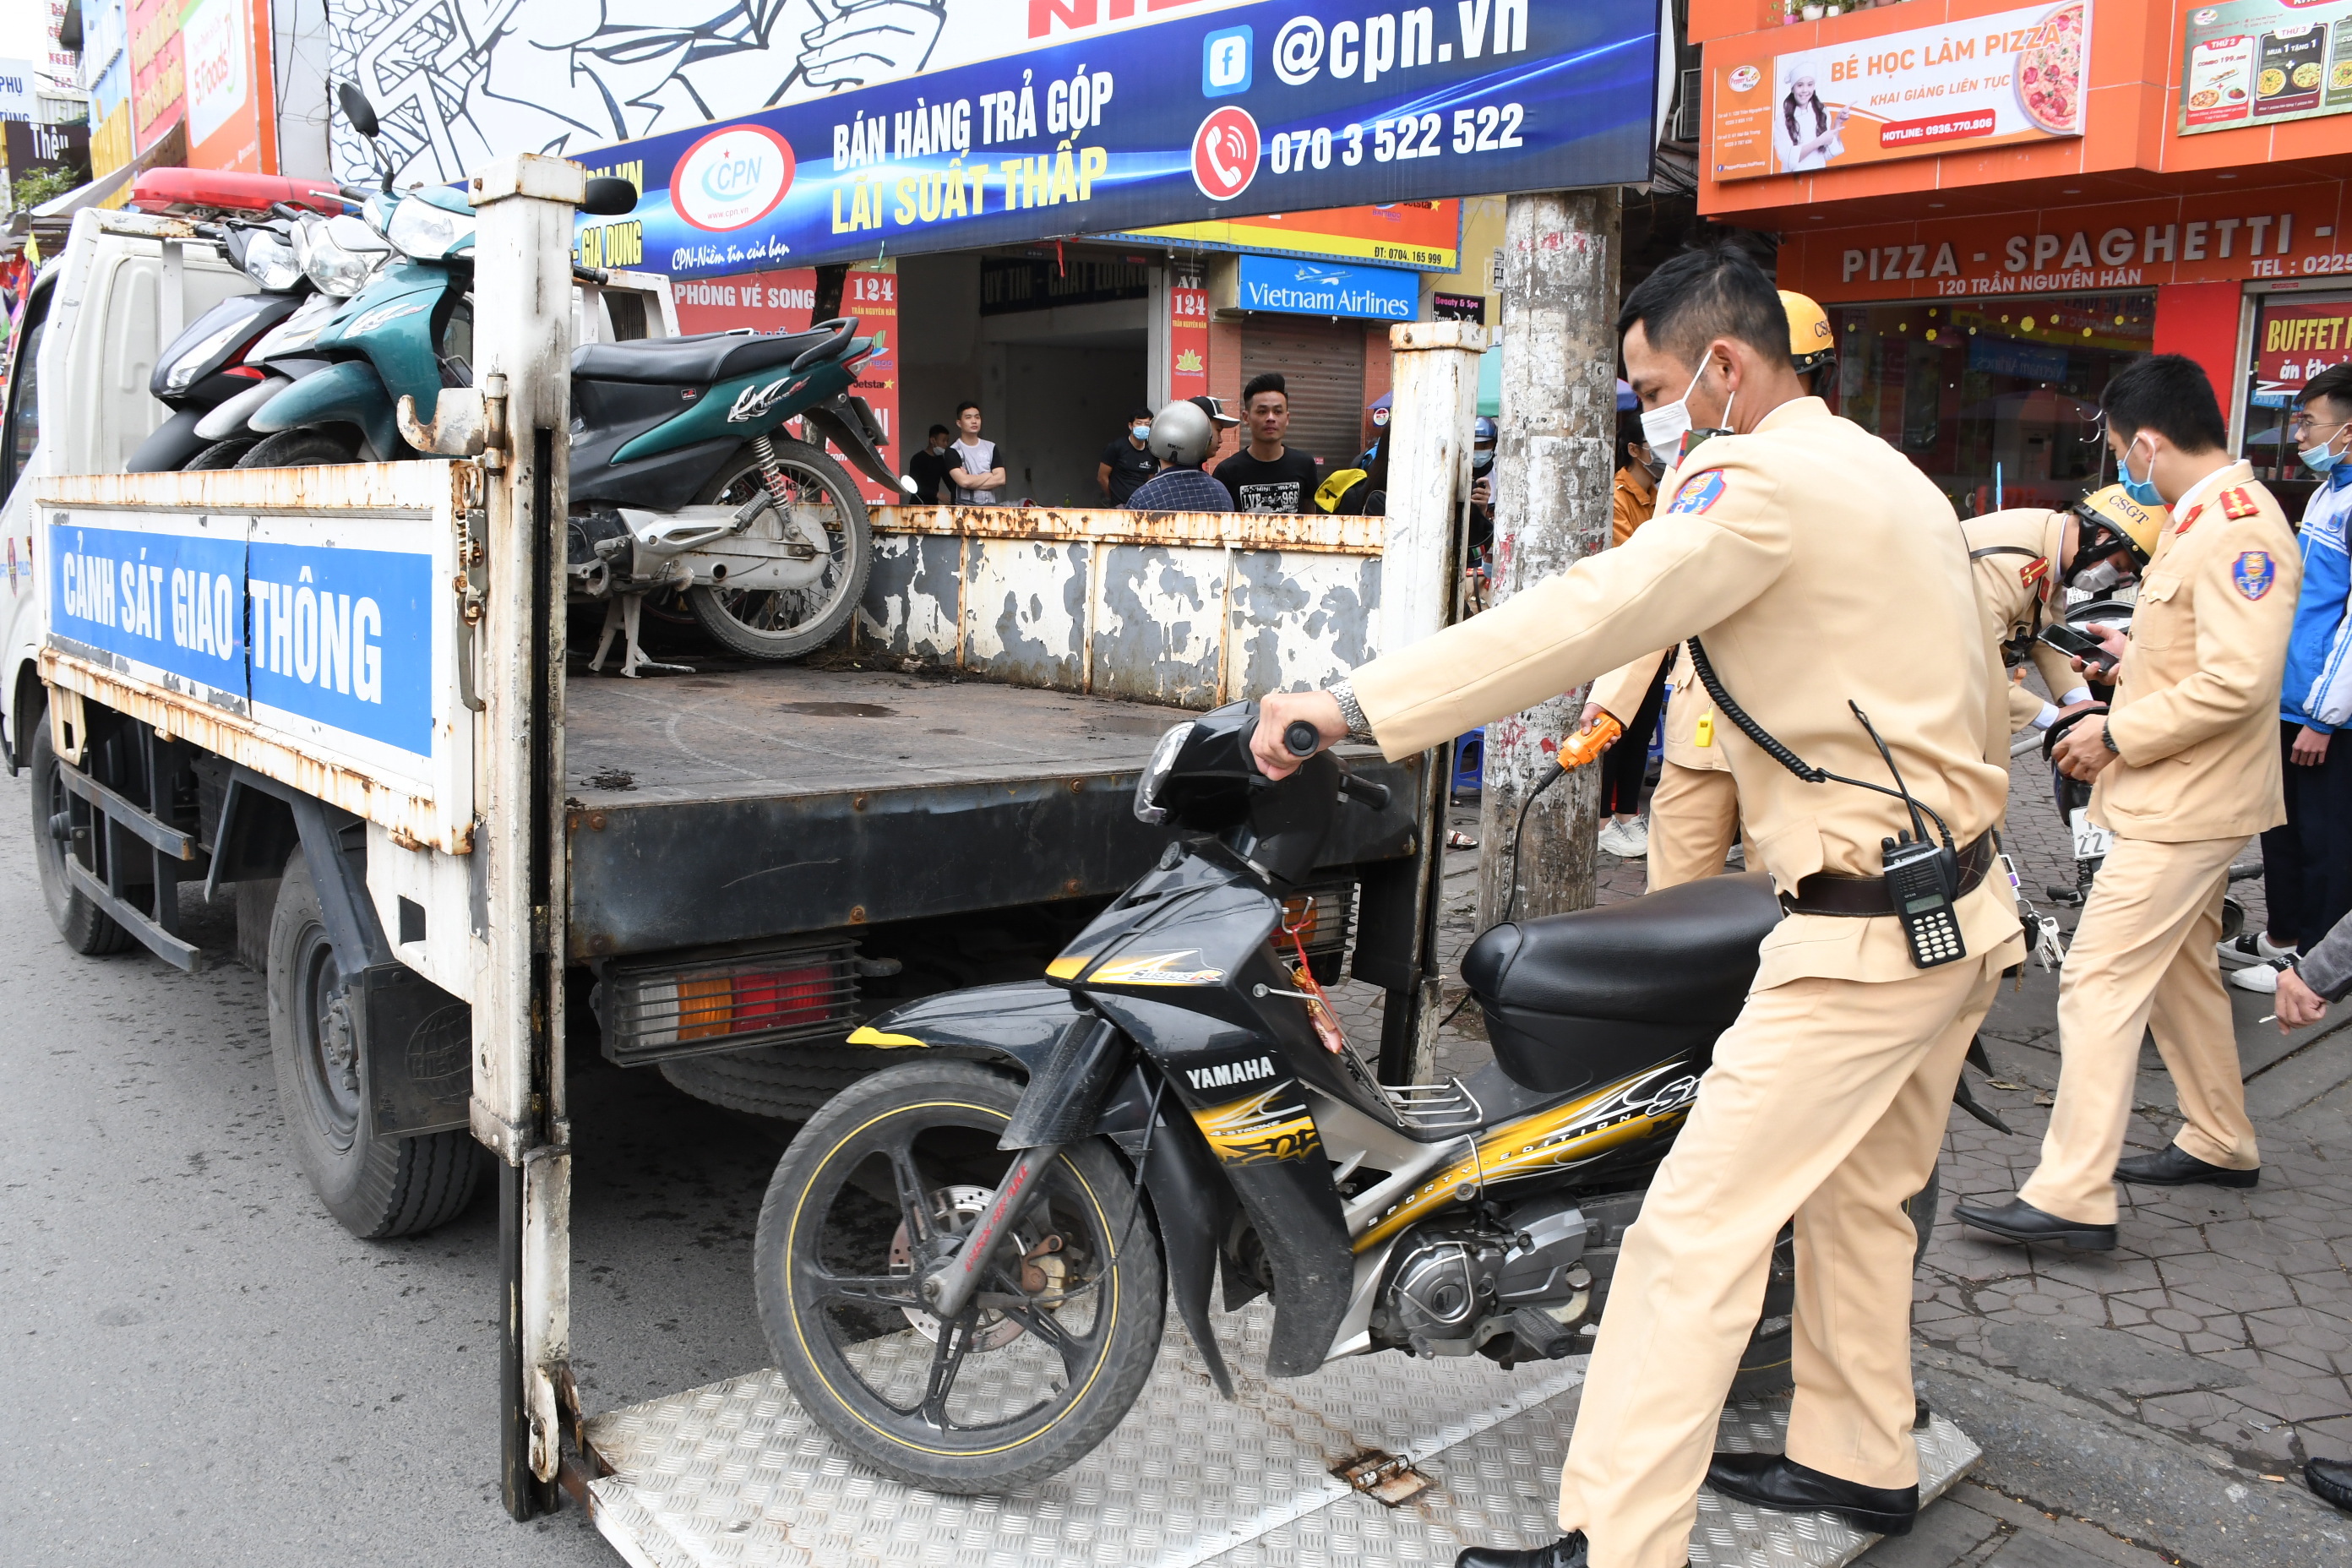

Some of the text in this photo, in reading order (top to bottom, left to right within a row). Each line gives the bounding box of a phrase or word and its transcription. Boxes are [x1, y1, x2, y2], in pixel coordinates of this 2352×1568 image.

[1272, 0, 1528, 85] @cpn.vn
[2281, 26, 2300, 36] THỨ
[2284, 43, 2289, 52] 1
[2311, 39, 2317, 48] 1
[1831, 23, 2061, 83] BÉ HỌC LÀM PIZZA
[1870, 74, 2011, 106] KHAI GIẢNG LIÊN TỤC
[833, 63, 1113, 172] BÁN HÀNG TRẢ GÓP
[1882, 117, 1993, 142] HOTLINE: 0936.770.806
[1271, 102, 1524, 174] 070 3 522 522
[717, 156, 763, 190] CPN
[832, 130, 1108, 235] LÃI SUẤT THẤP
[707, 206, 749, 220] www.cpn.vn
[581, 228, 603, 269] GIA
[605, 220, 643, 270] DỤNG
[727, 243, 745, 262] tin
[746, 240, 766, 260] của
[769, 234, 790, 264] bạn
[1388, 248, 1410, 261] 0704.
[1413, 251, 1426, 263] 165
[1428, 253, 1442, 264] 999
[1843, 242, 1959, 283] PIZZA
[2004, 214, 2293, 273] SPAGHETTI
[2251, 258, 2283, 277] TEL
[2303, 253, 2352, 274] 0225
[674, 280, 815, 310] PHÒNG VÉ SONG
[853, 277, 895, 302] 124
[1938, 266, 2142, 296] 120 TRẦN NGUYÊN HÃN
[865, 306, 885, 316] NGUYÊN
[1174, 293, 1206, 316] 124
[1249, 281, 1409, 317] Vietnam Airlines
[1435, 297, 1478, 310] Beauty & Spa
[2266, 317, 2344, 352] BUFFET
[2279, 358, 2300, 379] ăn
[852, 379, 885, 389] Jetstar
[2109, 494, 2150, 525] CSGT
[63, 530, 383, 705] CẢNH SÁT GIAO THÔNG
[1185, 1056, 1277, 1090] YAMAHA
